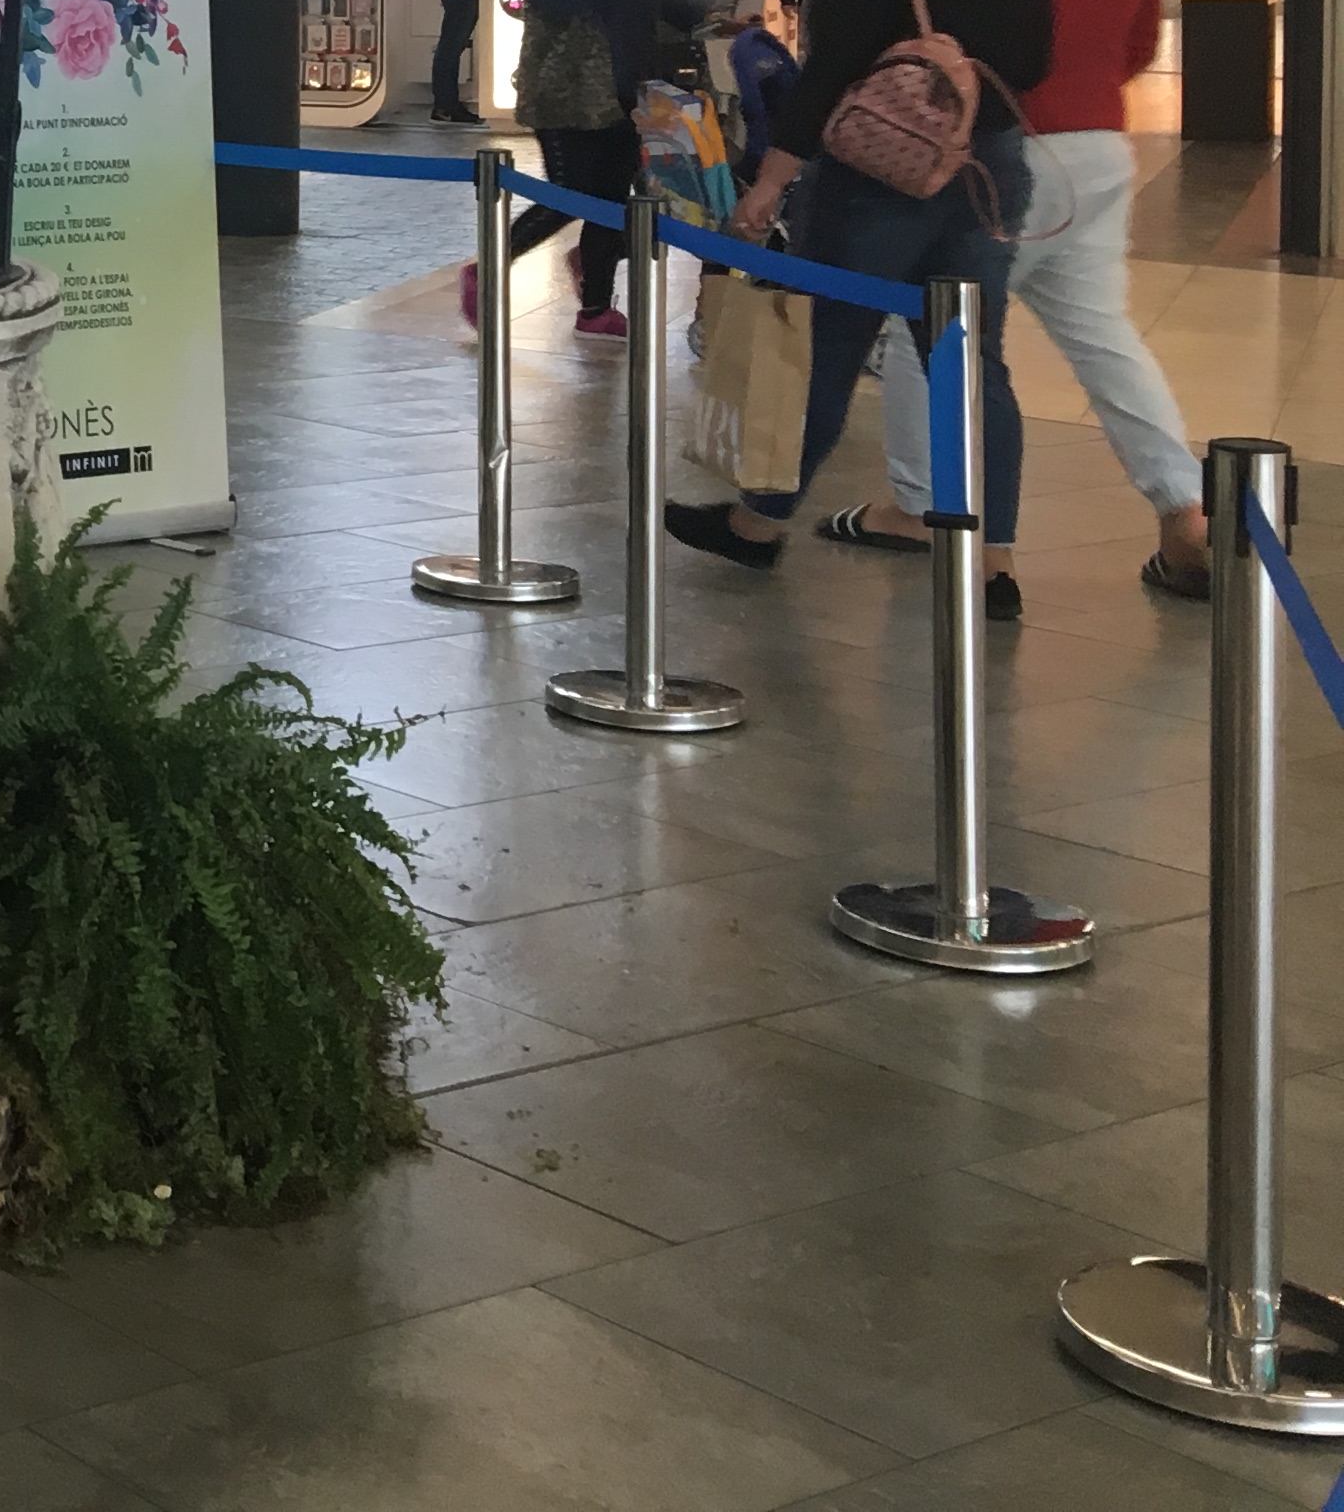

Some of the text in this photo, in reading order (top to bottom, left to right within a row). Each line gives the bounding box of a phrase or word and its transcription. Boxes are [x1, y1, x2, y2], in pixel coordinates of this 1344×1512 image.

[23, 119, 35, 130] AL
[36, 118, 59, 130] PUNT
[20, 162, 48, 174] CADA
[84, 158, 131, 171] DONAREM
[26, 176, 52, 188] BOLA
[53, 175, 66, 187] DE
[23, 216, 112, 232] ESCRIU EL TEU DESIG
[17, 234, 52, 248] LLENÇA
[54, 233, 66, 245] LA
[67, 232, 92, 244] BOLA
[93, 231, 105, 243] AL
[106, 230, 126, 242] POU
[63, 275, 88, 287] FOTO
[90, 274, 97, 286] A
[81, 290, 94, 301] DE
[63, 304, 88, 317] ESPAI
[65, 454, 120, 472] INFINIT
